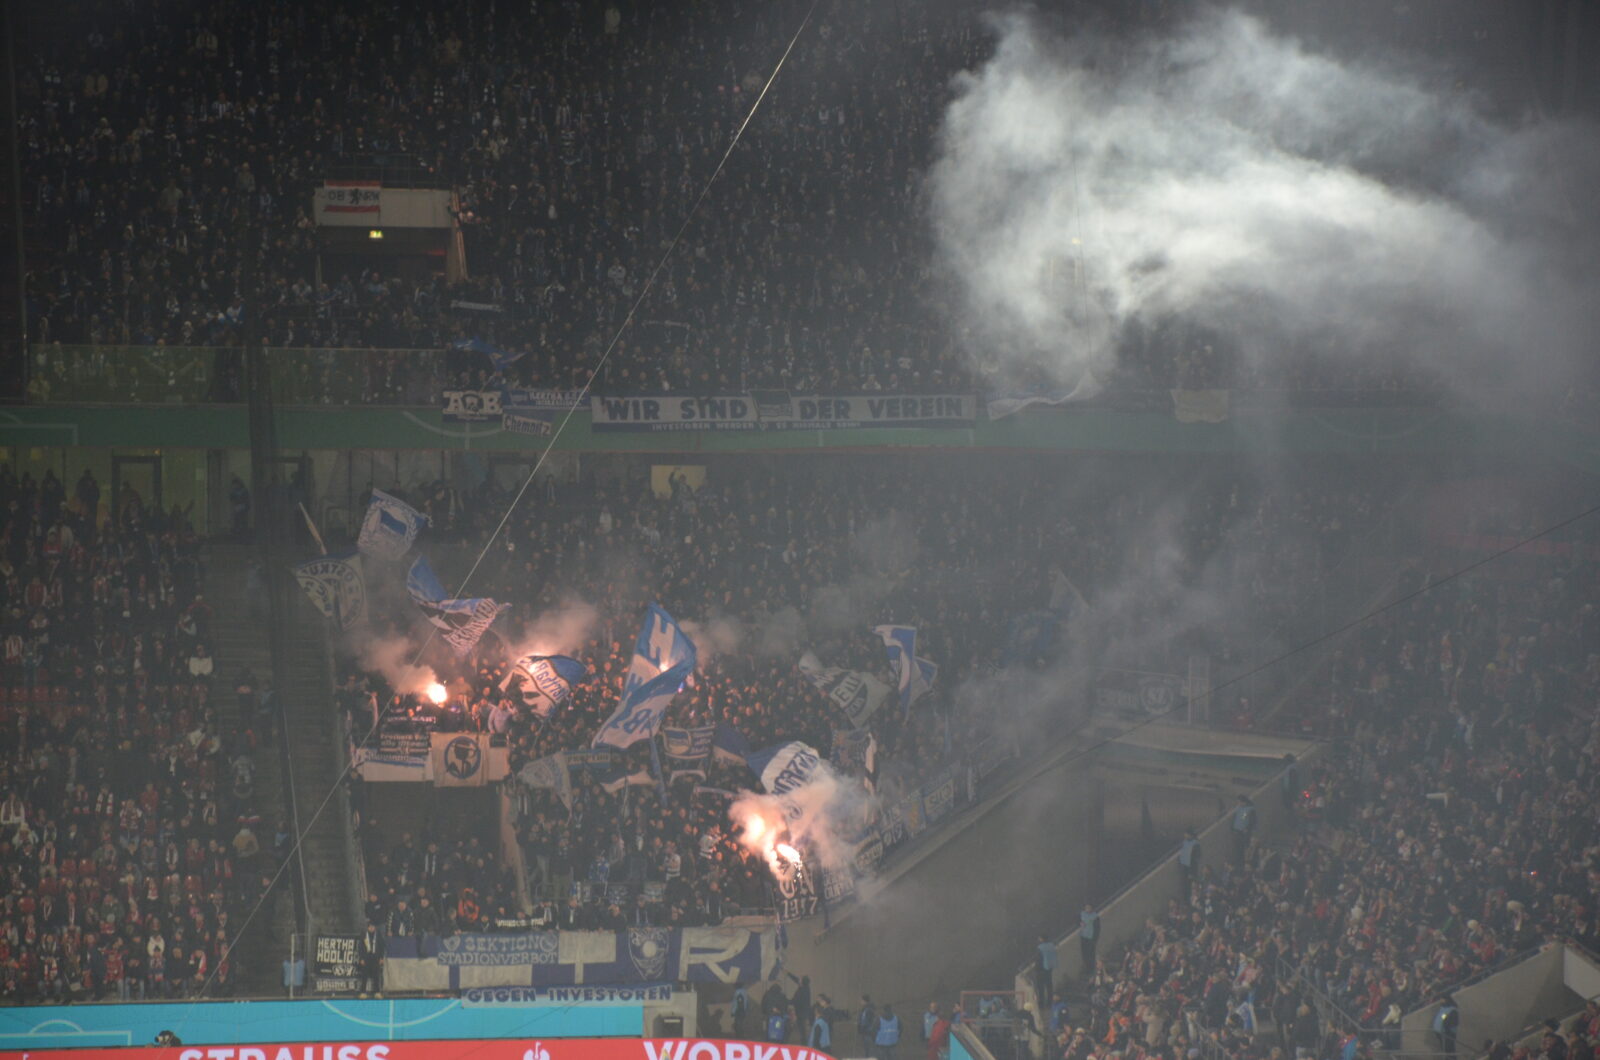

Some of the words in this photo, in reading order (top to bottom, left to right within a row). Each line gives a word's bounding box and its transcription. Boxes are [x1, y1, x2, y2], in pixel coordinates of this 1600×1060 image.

[606, 399, 660, 421] WIR
[680, 398, 748, 420] SIND
[799, 399, 850, 420] DER
[866, 398, 962, 419] VEREIN
[317, 937, 354, 951] HERTHA
[465, 934, 539, 953] SEKTION
[438, 951, 557, 966] STADIONVERBOT
[467, 987, 537, 1003] GEGEN
[549, 984, 673, 1002] INVESTOREN
